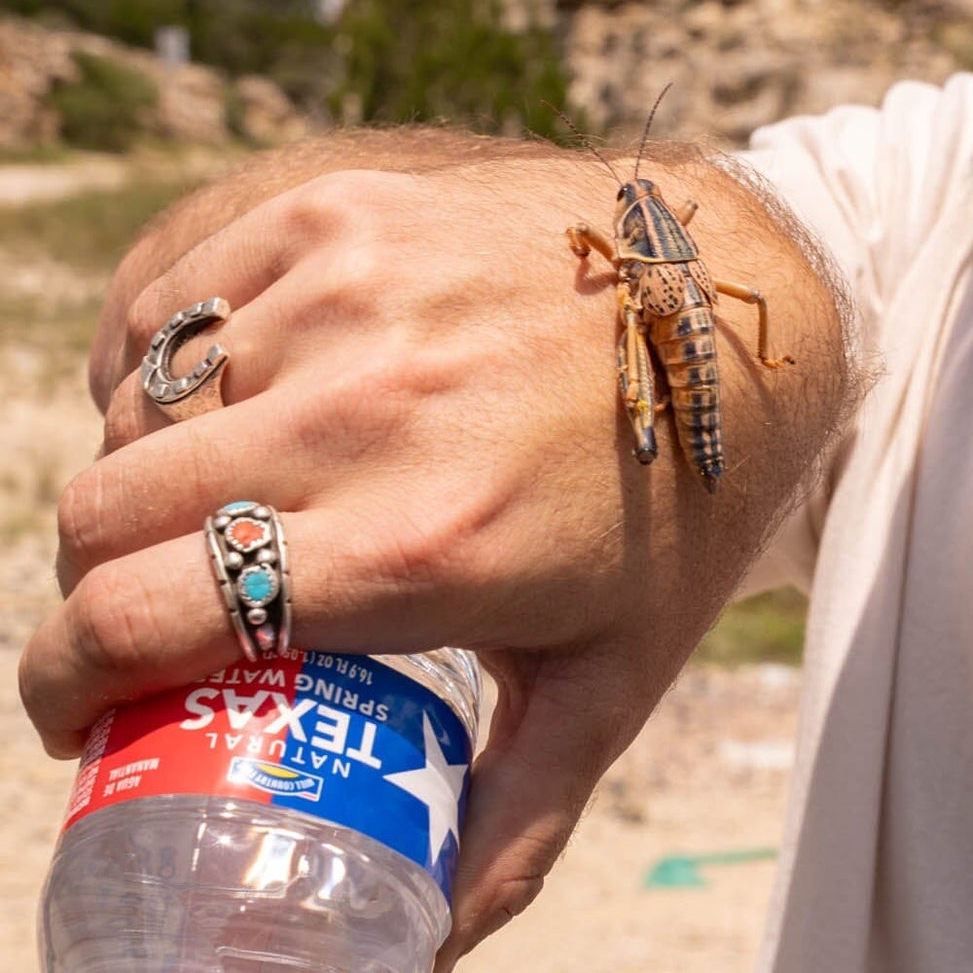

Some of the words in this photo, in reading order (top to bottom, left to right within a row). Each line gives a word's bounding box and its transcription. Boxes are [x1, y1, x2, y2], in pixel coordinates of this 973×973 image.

[317, 654, 334, 668] OZ
[336, 657, 349, 673] FL
[197, 668, 286, 688] WATE
[349, 663, 373, 685] 16.9
[294, 673, 389, 721] SPRING
[179, 687, 382, 770] TEXAS
[204, 732, 351, 779] NATURAL
[109, 757, 160, 782] MANANTIAL
[103, 781, 115, 798] DE
[116, 775, 142, 792] AGUA
[255, 774, 294, 791] COUNTRY
